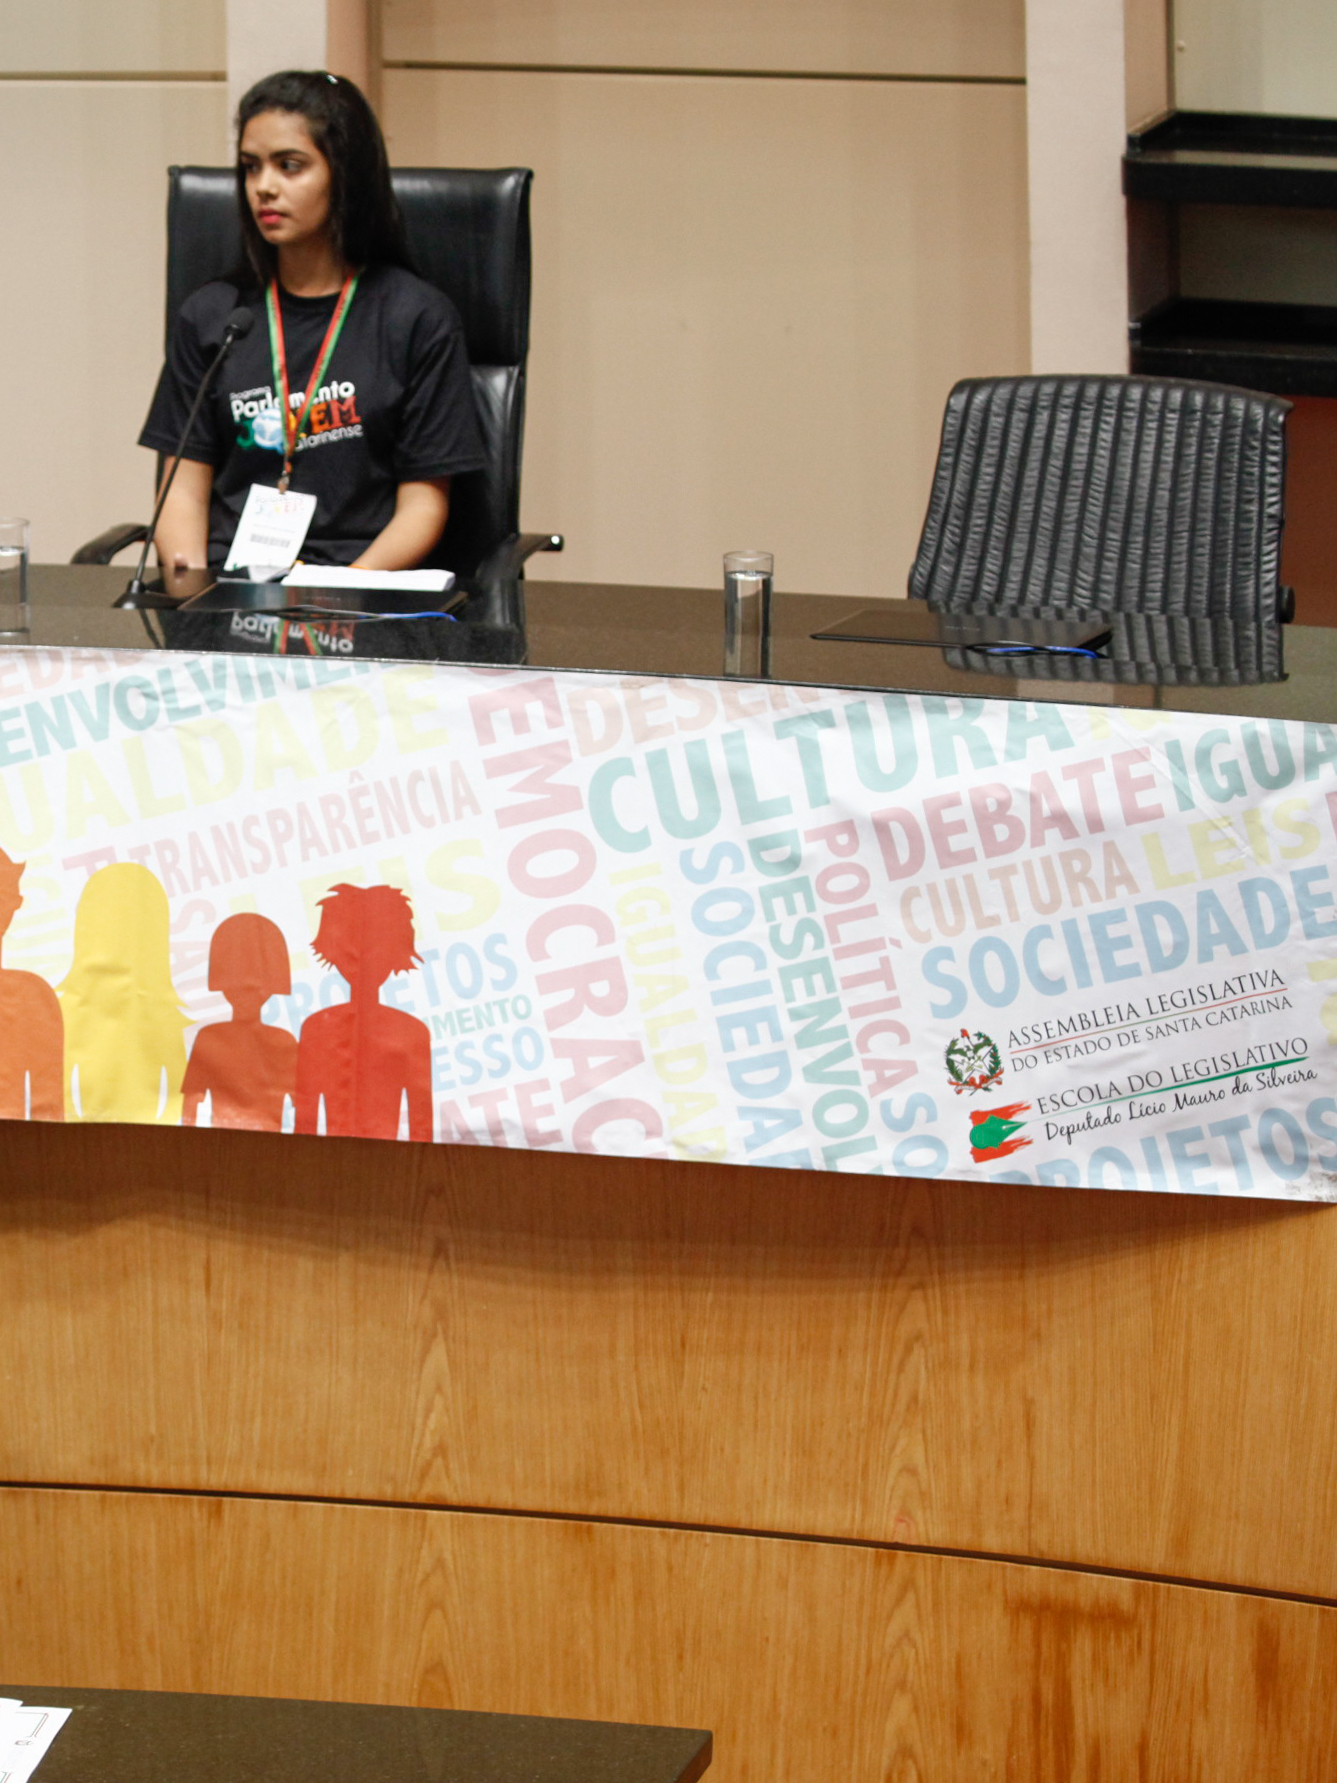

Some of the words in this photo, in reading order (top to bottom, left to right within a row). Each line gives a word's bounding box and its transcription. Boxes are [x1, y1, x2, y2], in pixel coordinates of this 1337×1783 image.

[230, 380, 356, 423] Parlmnto
[588, 693, 1075, 854] CULTURA
[870, 747, 1165, 882] DEBATE
[1140, 798, 1324, 892] LEIS
[899, 840, 1140, 944] CULTURA
[921, 864, 1337, 1020] SOCIEDADE
[1007, 1002, 1142, 1049] ASSEMBLEIA
[1145, 968, 1285, 1016] LEGISLATIVA
[1011, 1054, 1038, 1072] DO
[1045, 1035, 1113, 1064] ESTADO
[1117, 1030, 1142, 1047] DE
[1145, 1018, 1202, 1042] SANTA
[1205, 995, 1293, 1027] CATARINA
[1035, 1080, 1123, 1115] ESCOLA
[1127, 1069, 1164, 1093] DO
[1169, 1036, 1309, 1084] LEGISLATIVO
[1044, 1106, 1122, 1146] Deputado
[1128, 1099, 1167, 1121] Lício
[1171, 1088, 1227, 1113] Mauro
[1231, 1076, 1253, 1096] da
[1255, 1066, 1319, 1092] Silveira
